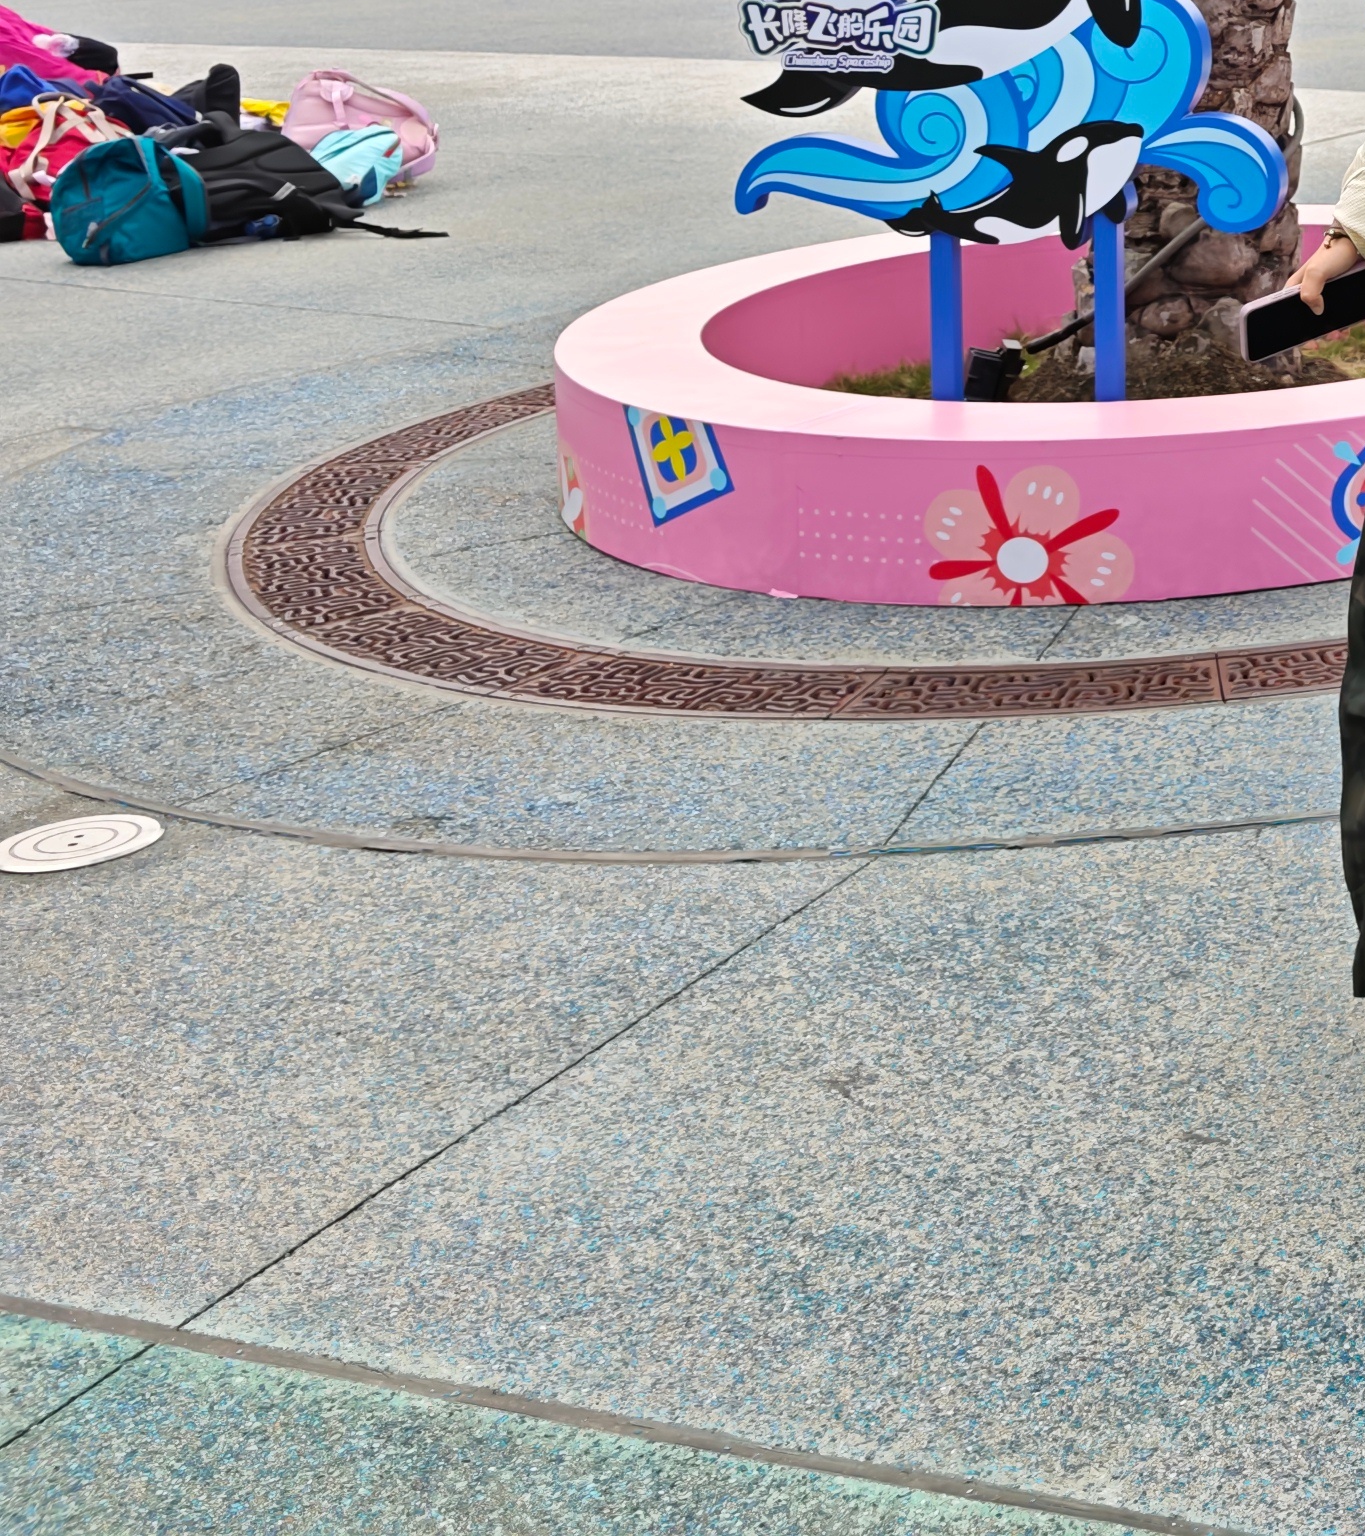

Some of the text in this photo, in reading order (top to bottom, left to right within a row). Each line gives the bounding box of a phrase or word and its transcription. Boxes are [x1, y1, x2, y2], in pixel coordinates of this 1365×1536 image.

[748, 2, 934, 52] 长隆飞船乐园
[785, 54, 891, 69] Chimelong Spaceship
